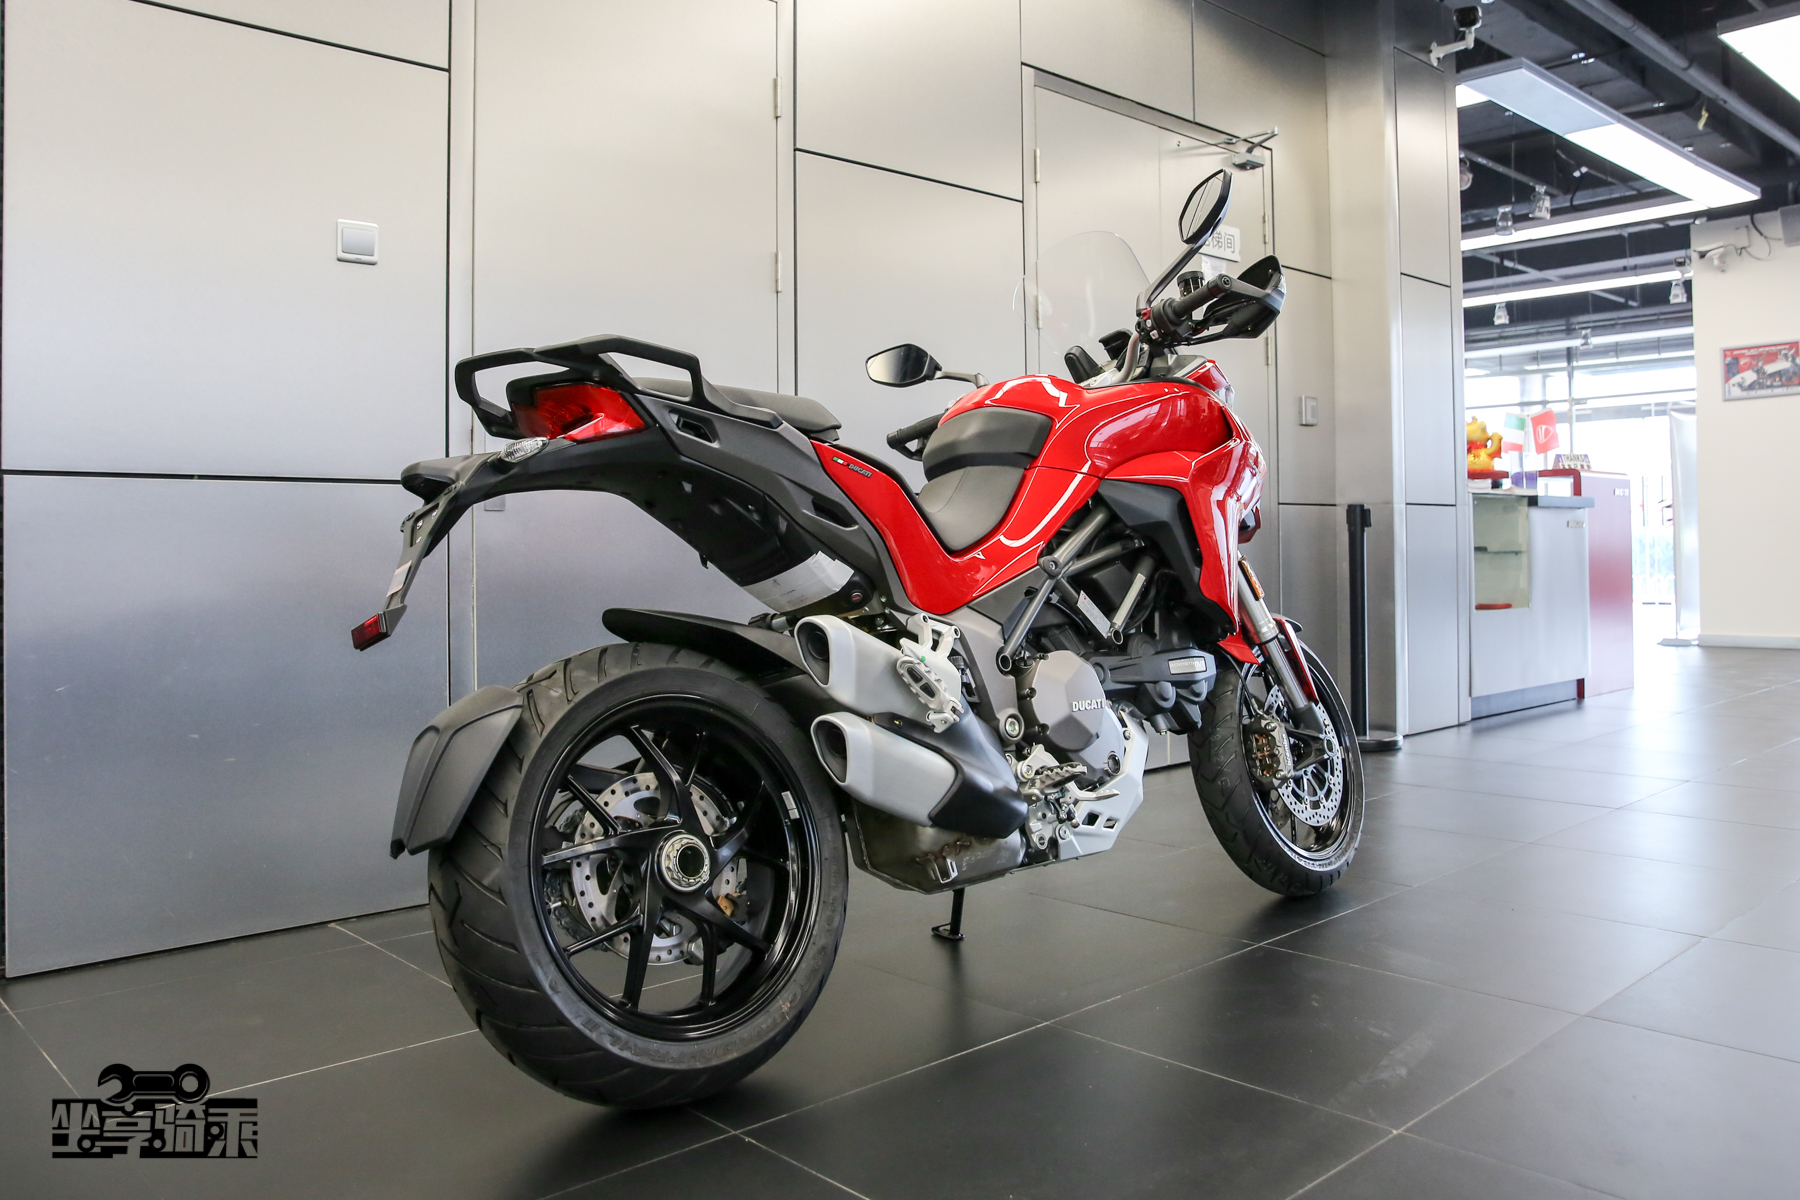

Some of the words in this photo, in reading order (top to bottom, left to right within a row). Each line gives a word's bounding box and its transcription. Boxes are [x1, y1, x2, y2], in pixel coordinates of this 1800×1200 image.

[1204, 230, 1236, 253] 梯间
[849, 464, 873, 478] DUCATI
[1072, 699, 1105, 711] DUCATI
